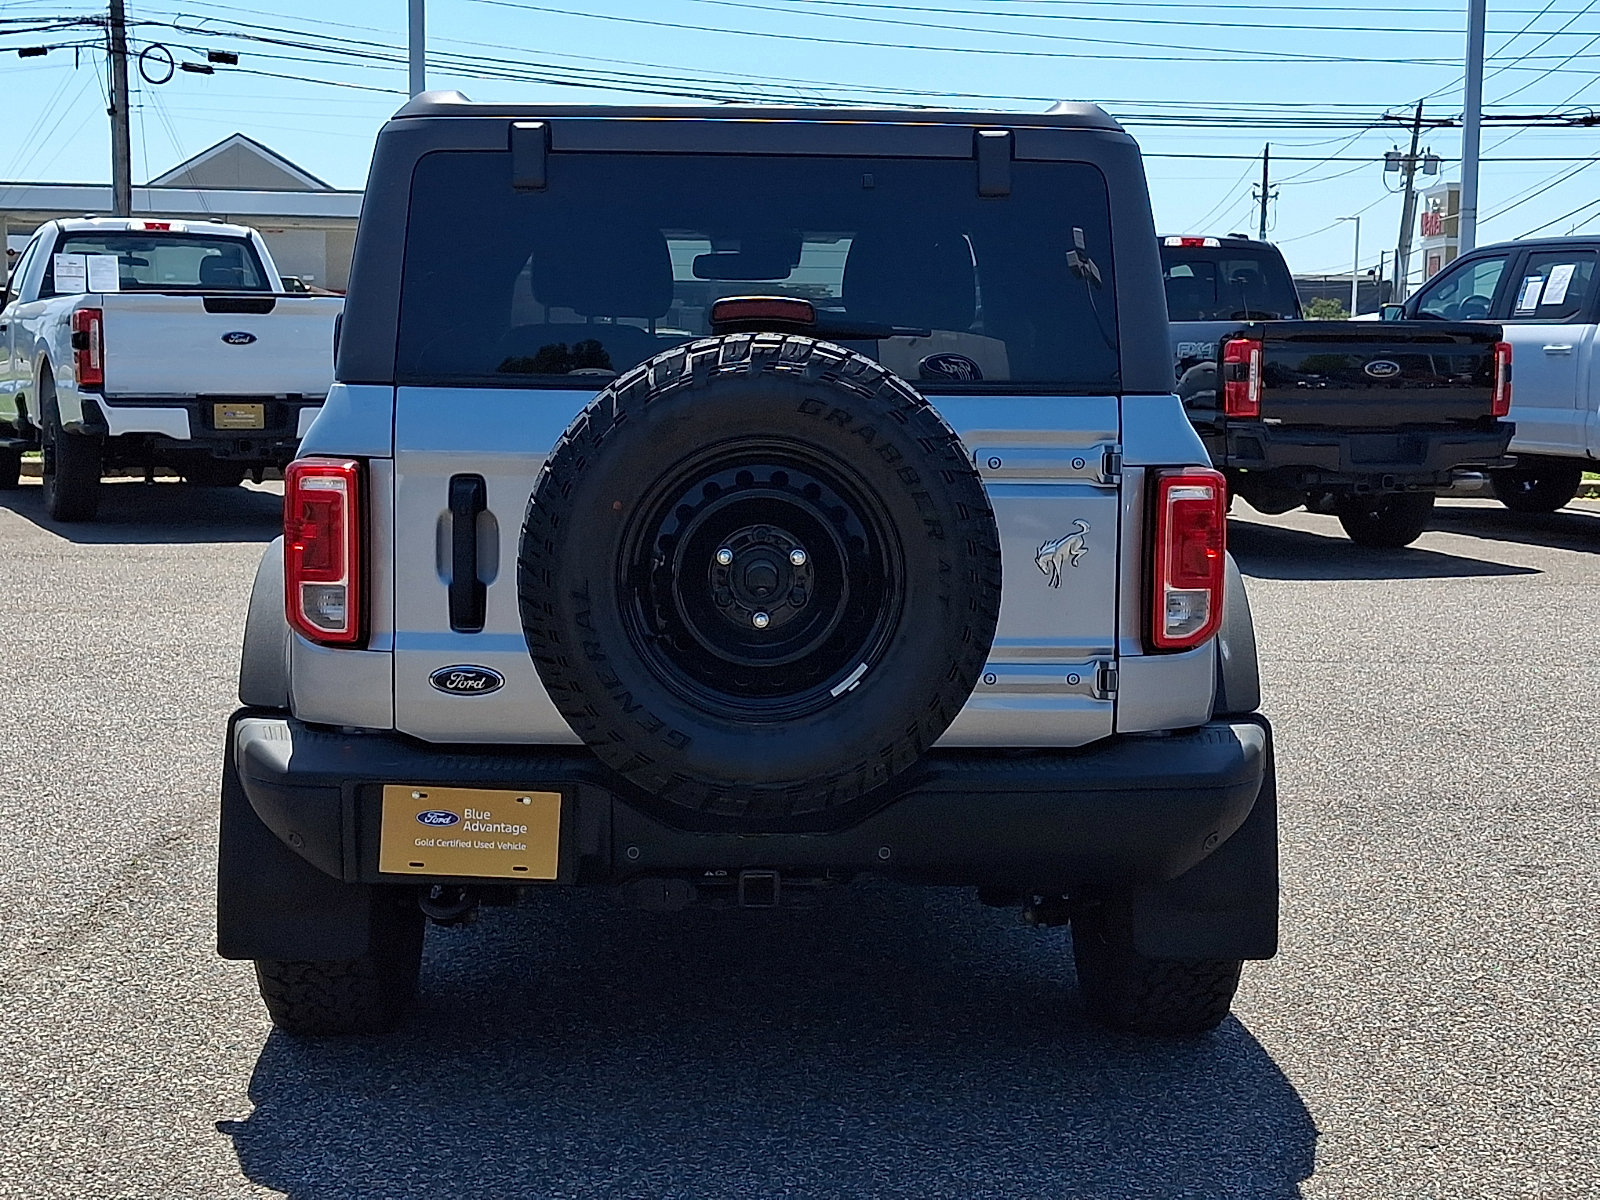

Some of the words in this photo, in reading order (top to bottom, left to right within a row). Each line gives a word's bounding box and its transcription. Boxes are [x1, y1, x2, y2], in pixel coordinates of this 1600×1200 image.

[1177, 342, 1215, 360] FX4
[796, 398, 944, 540] GRABBER
[573, 579, 692, 750] GENERAL
[446, 671, 487, 689] Ford
[424, 811, 452, 824] Ford
[464, 808, 491, 820] Blue
[463, 821, 528, 836] Advantage
[414, 838, 435, 847] Gold
[436, 839, 472, 848] Certified
[473, 841, 495, 849] Used
[497, 842, 527, 851] Vehicle
